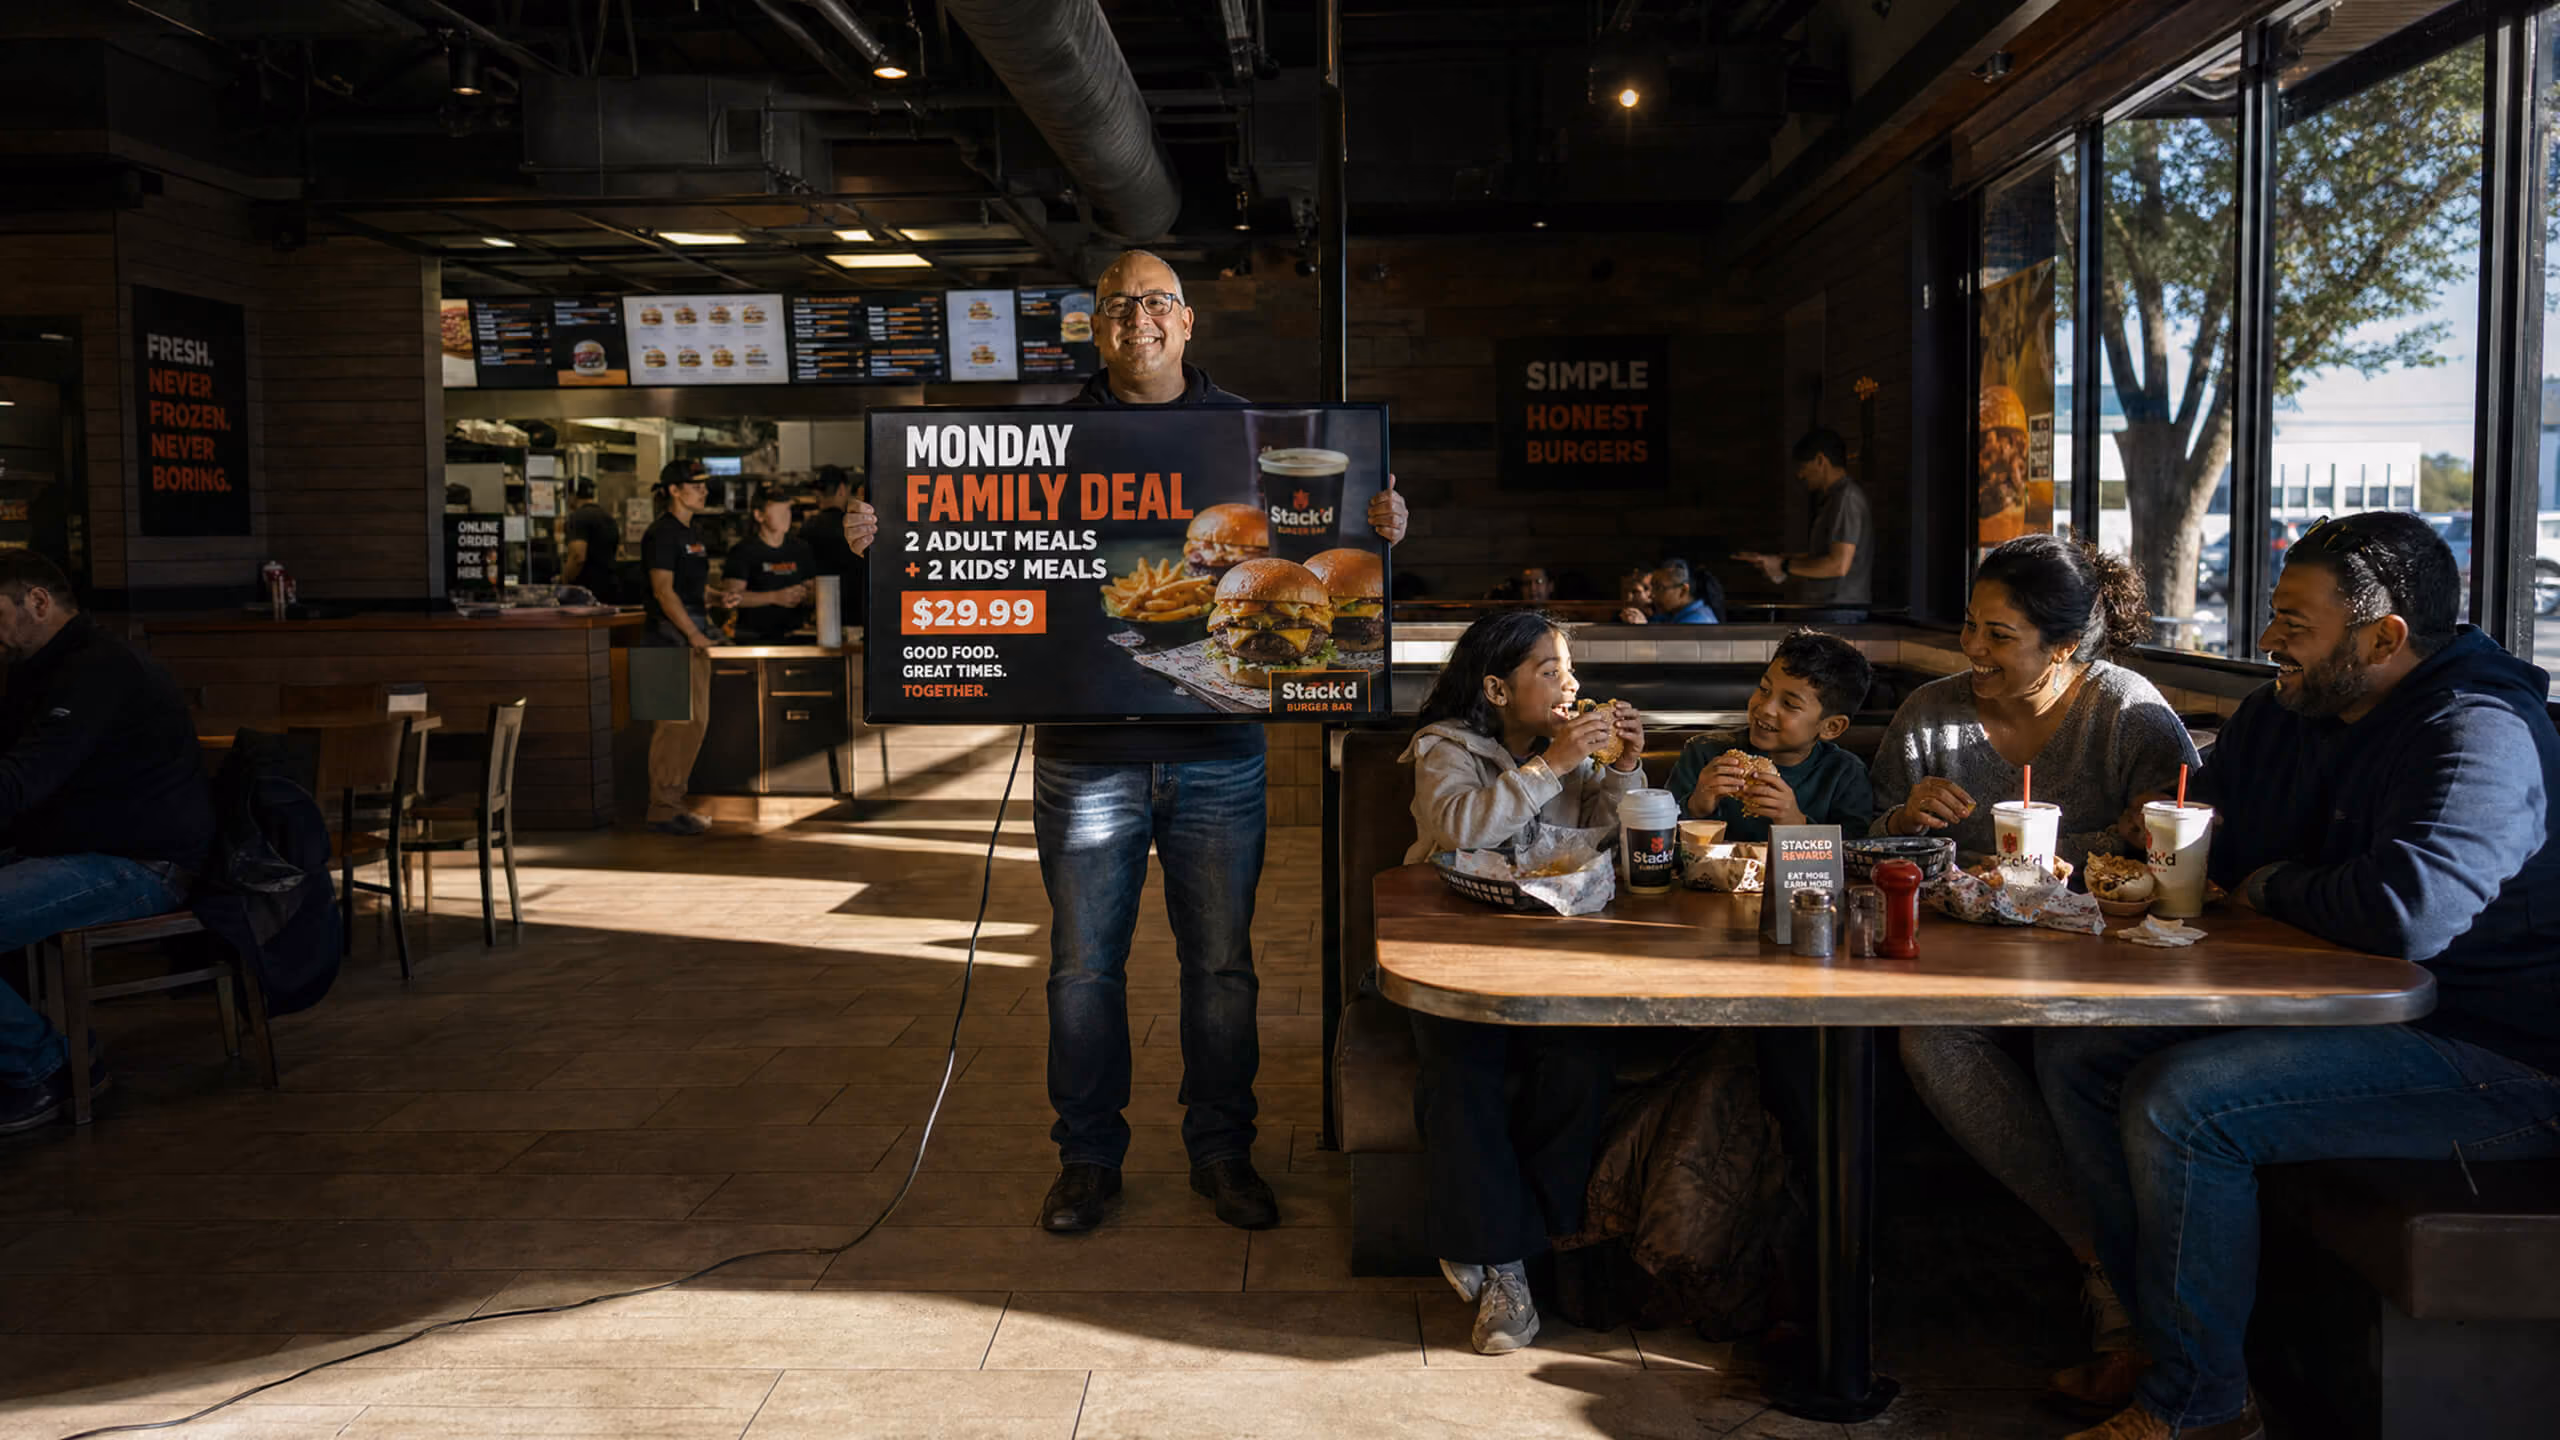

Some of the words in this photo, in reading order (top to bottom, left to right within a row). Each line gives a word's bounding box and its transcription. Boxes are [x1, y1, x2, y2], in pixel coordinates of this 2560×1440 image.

[147, 332, 214, 368] FRESH.
[149, 367, 214, 401] NEVER
[1526, 361, 1649, 391] SIMPLE
[150, 399, 231, 432] FROZEN.
[1526, 404, 1649, 431] HONEST
[151, 432, 215, 461] NEVER
[906, 424, 1073, 468] MONDAY
[1527, 439, 1648, 464] BURGERS
[152, 465, 232, 493] BORING.
[906, 473, 1068, 522] FAMILY
[1081, 472, 1194, 521] DEAL
[1270, 505, 1334, 526] Stack'd
[458, 521, 499, 533] ONLINE
[457, 534, 499, 547] ORDER
[905, 531, 920, 552] 2
[925, 530, 1008, 552] ADULT
[1014, 529, 1097, 551] MEALS
[457, 551, 481, 564] PICK
[457, 566, 482, 579] HERE
[927, 559, 943, 580] 2
[1023, 558, 1107, 580] MEALS
[911, 595, 1035, 628] $29.99
[903, 645, 948, 660] GOOD
[952, 645, 999, 660] FOOD.
[903, 663, 953, 678] GREAT
[956, 663, 1007, 678] TIMES.
[902, 683, 988, 698] TOGETHER.
[1282, 681, 1358, 701] Stack'd
[1287, 702, 1330, 712] BURGER
[1331, 702, 1353, 712] BAR
[1781, 839, 1833, 850] STACKED
[1781, 850, 1833, 861] REWARDS
[1784, 880, 1808, 889] EARN
[1810, 880, 1833, 889] MORE
[1787, 872, 1803, 880] EAT
[1806, 871, 1830, 880] MORE
